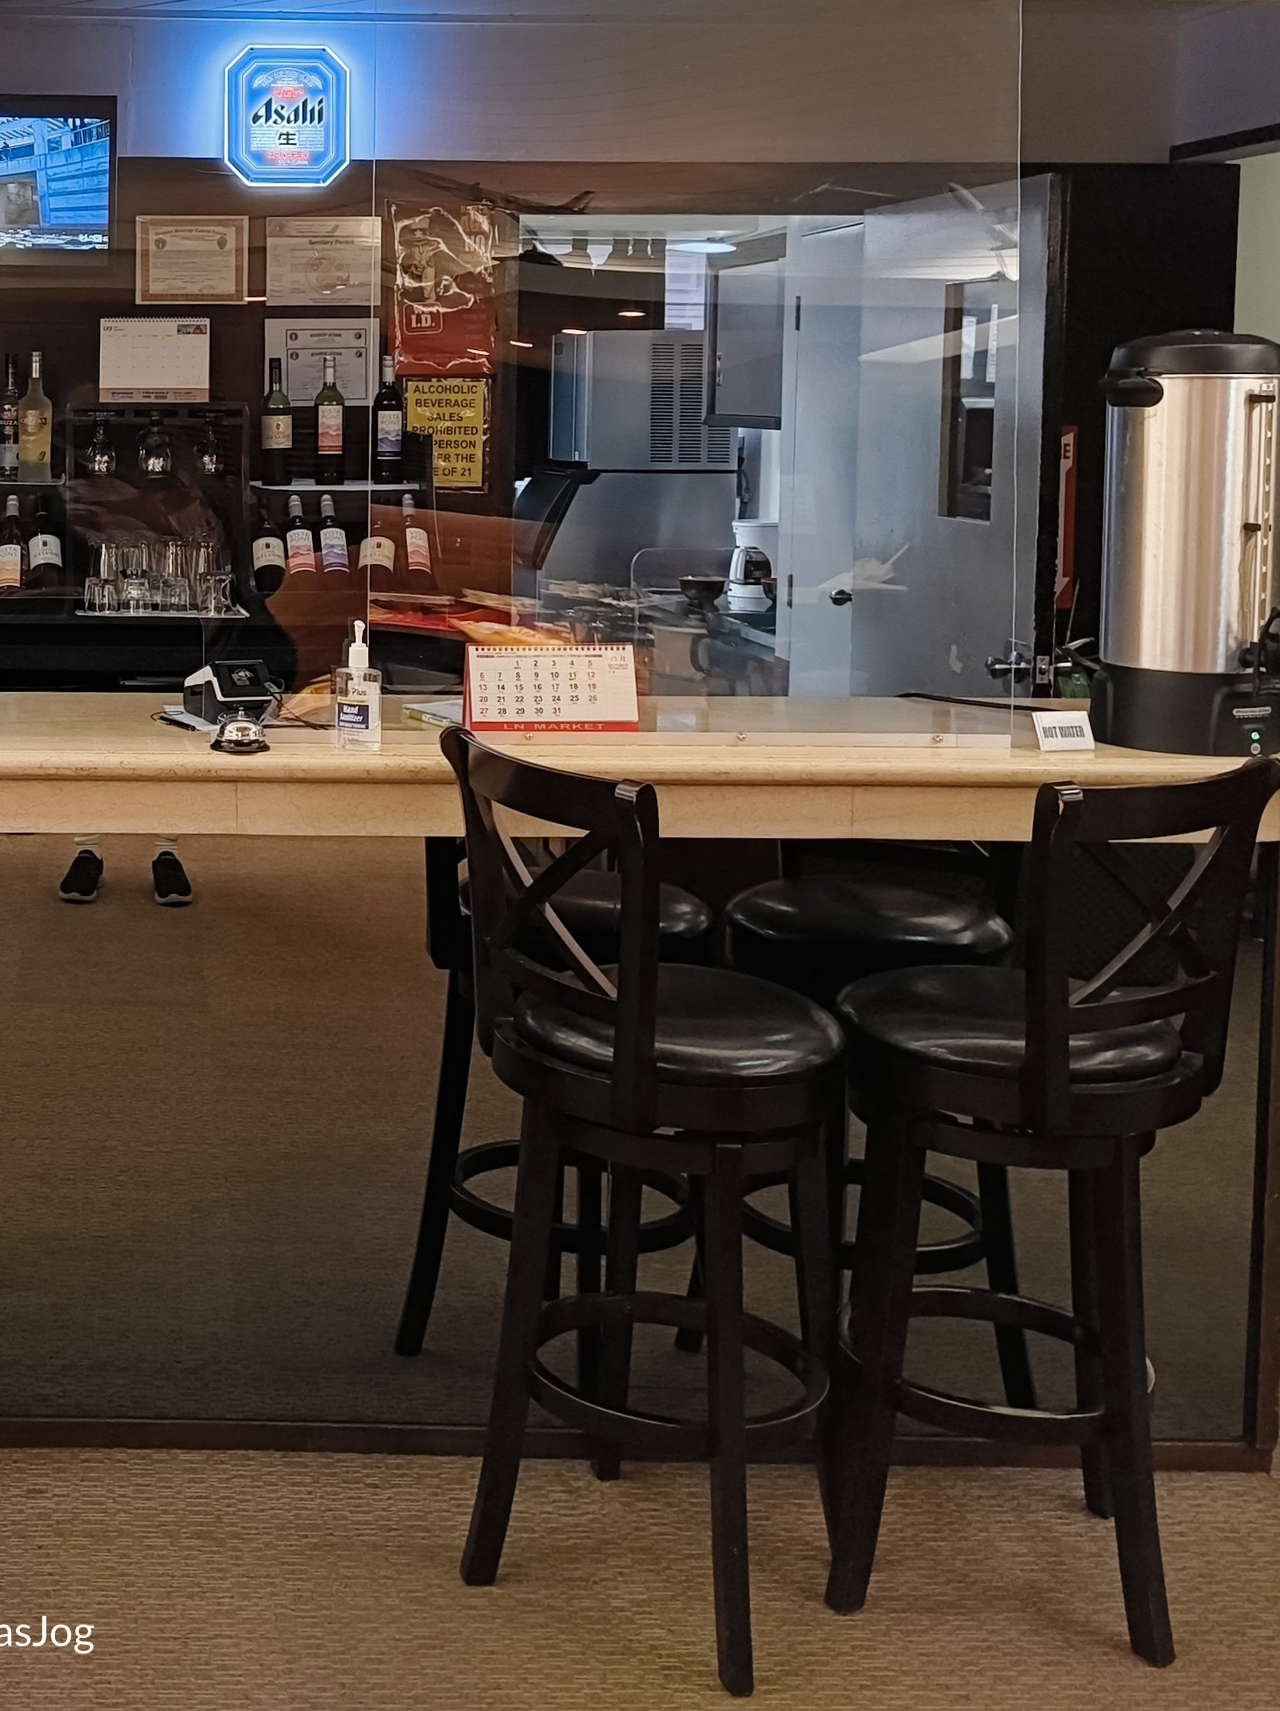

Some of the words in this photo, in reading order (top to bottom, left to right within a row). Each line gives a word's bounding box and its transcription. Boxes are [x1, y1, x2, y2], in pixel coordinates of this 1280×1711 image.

[251, 97, 324, 125] Asahi
[278, 131, 297, 146] 生
[410, 314, 436, 328] I.D.
[413, 385, 478, 394] ALCOHOLIC
[415, 398, 476, 408] BEVERAGE
[427, 412, 464, 422] SALES
[412, 426, 479, 436] PROHIBITED
[434, 440, 477, 449] PERSON
[455, 454, 476, 463] THE
[442, 467, 458, 476] OF
[460, 467, 472, 477] 21
[1042, 726, 1058, 739] HOT
[1058, 725, 1086, 739] WATER
